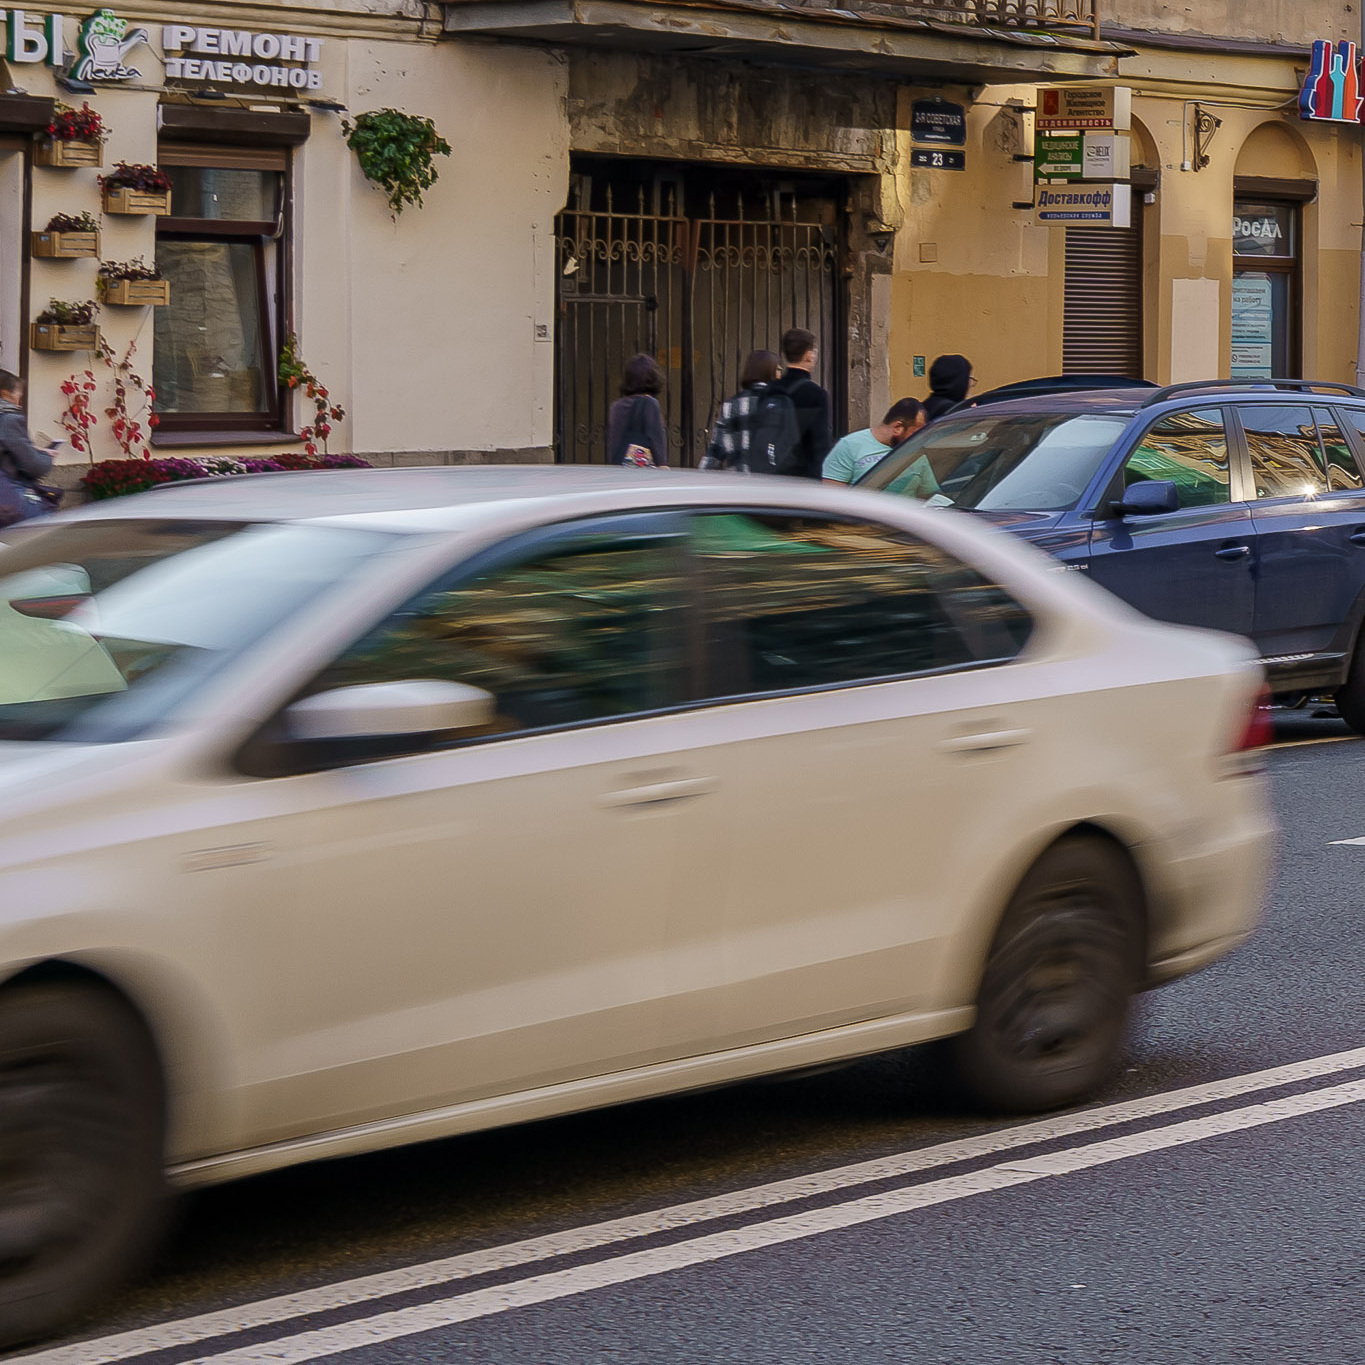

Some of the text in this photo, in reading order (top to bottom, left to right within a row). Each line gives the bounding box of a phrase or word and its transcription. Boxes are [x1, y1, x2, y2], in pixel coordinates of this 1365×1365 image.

[163, 25, 325, 62] РЕМОНТ
[165, 58, 323, 89] ТЕЛЕФОНОВ
[1068, 109, 1105, 117] Агентство
[1039, 119, 1111, 127] НЕДВИЖИМОСТЬ
[932, 152, 944, 166] 23
[1038, 190, 1111, 208] Доставкофф
